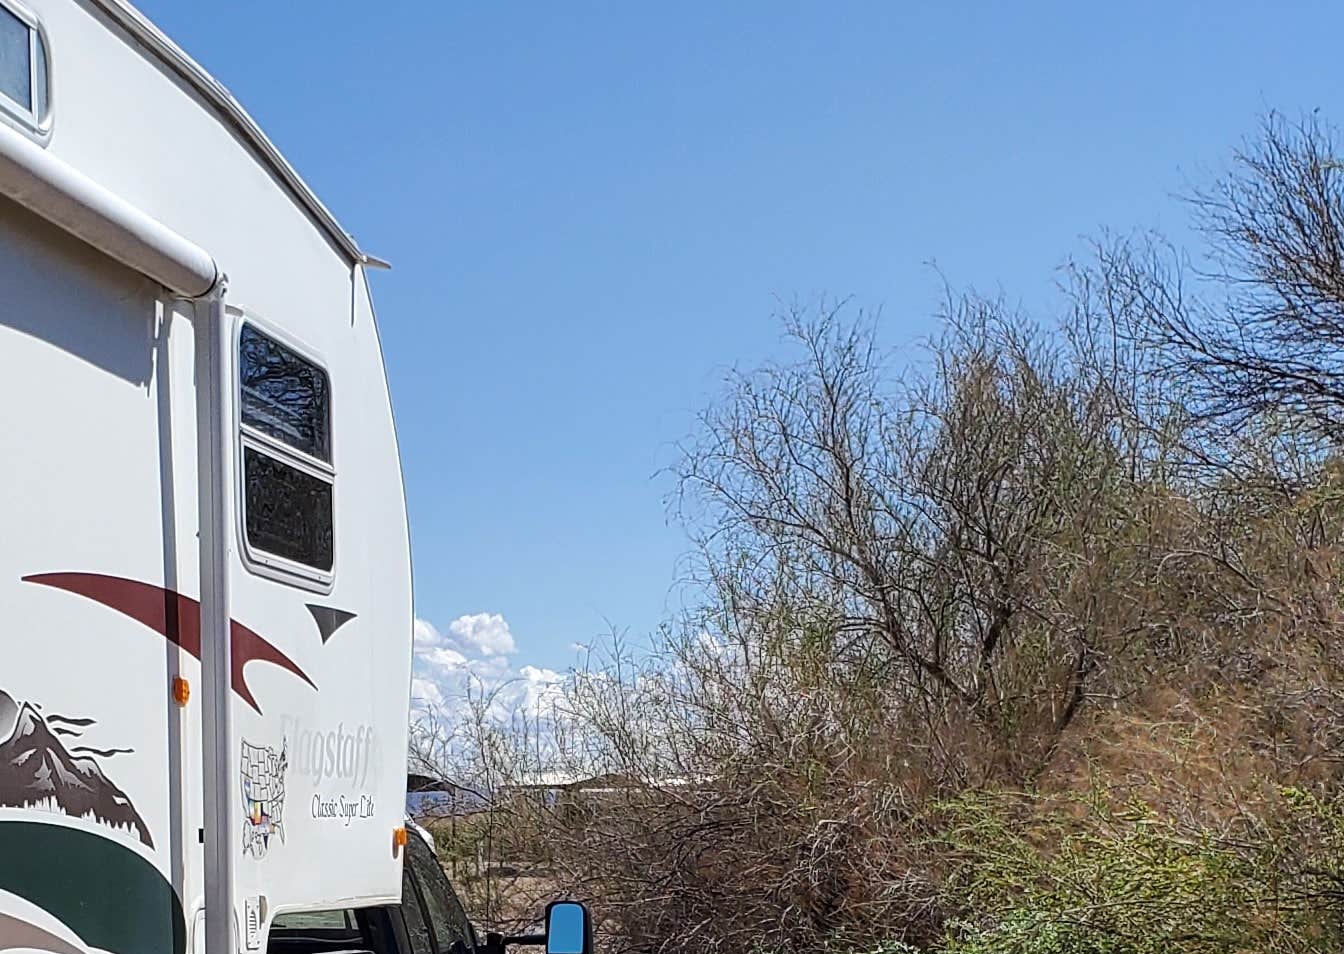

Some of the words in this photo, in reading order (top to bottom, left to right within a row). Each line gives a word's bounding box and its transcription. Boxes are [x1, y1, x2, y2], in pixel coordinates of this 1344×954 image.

[280, 714, 373, 789] Flagstaff
[312, 794, 339, 819] Classic
[340, 794, 361, 828] Super
[360, 794, 375, 819] Lite
